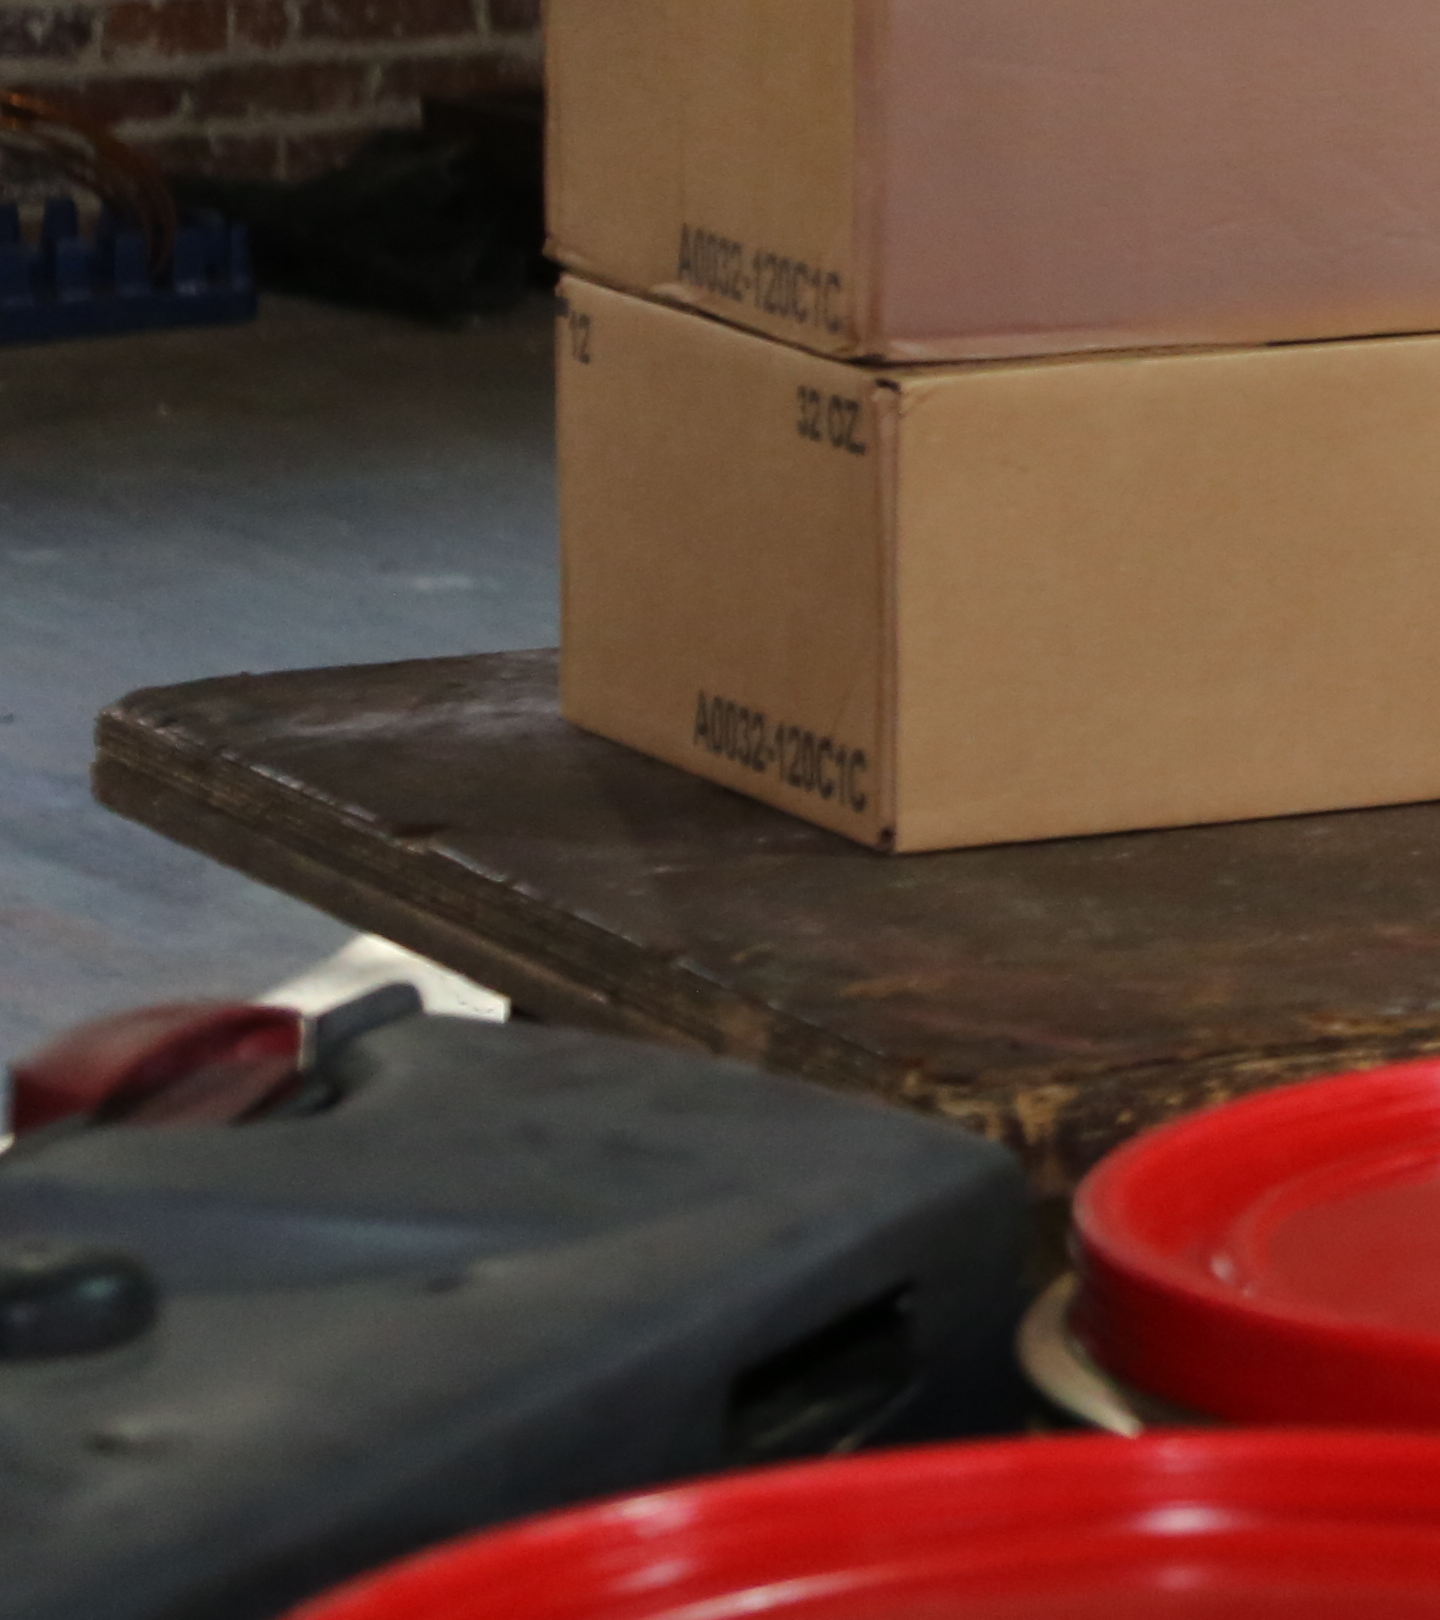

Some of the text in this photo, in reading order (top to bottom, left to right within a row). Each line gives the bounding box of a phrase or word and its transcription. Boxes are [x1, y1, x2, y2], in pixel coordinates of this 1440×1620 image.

[678, 222, 842, 334] A0032-120C1C
[569, 310, 592, 365] 12
[796, 385, 821, 443] 32
[693, 690, 868, 813] A0032-120C1C
